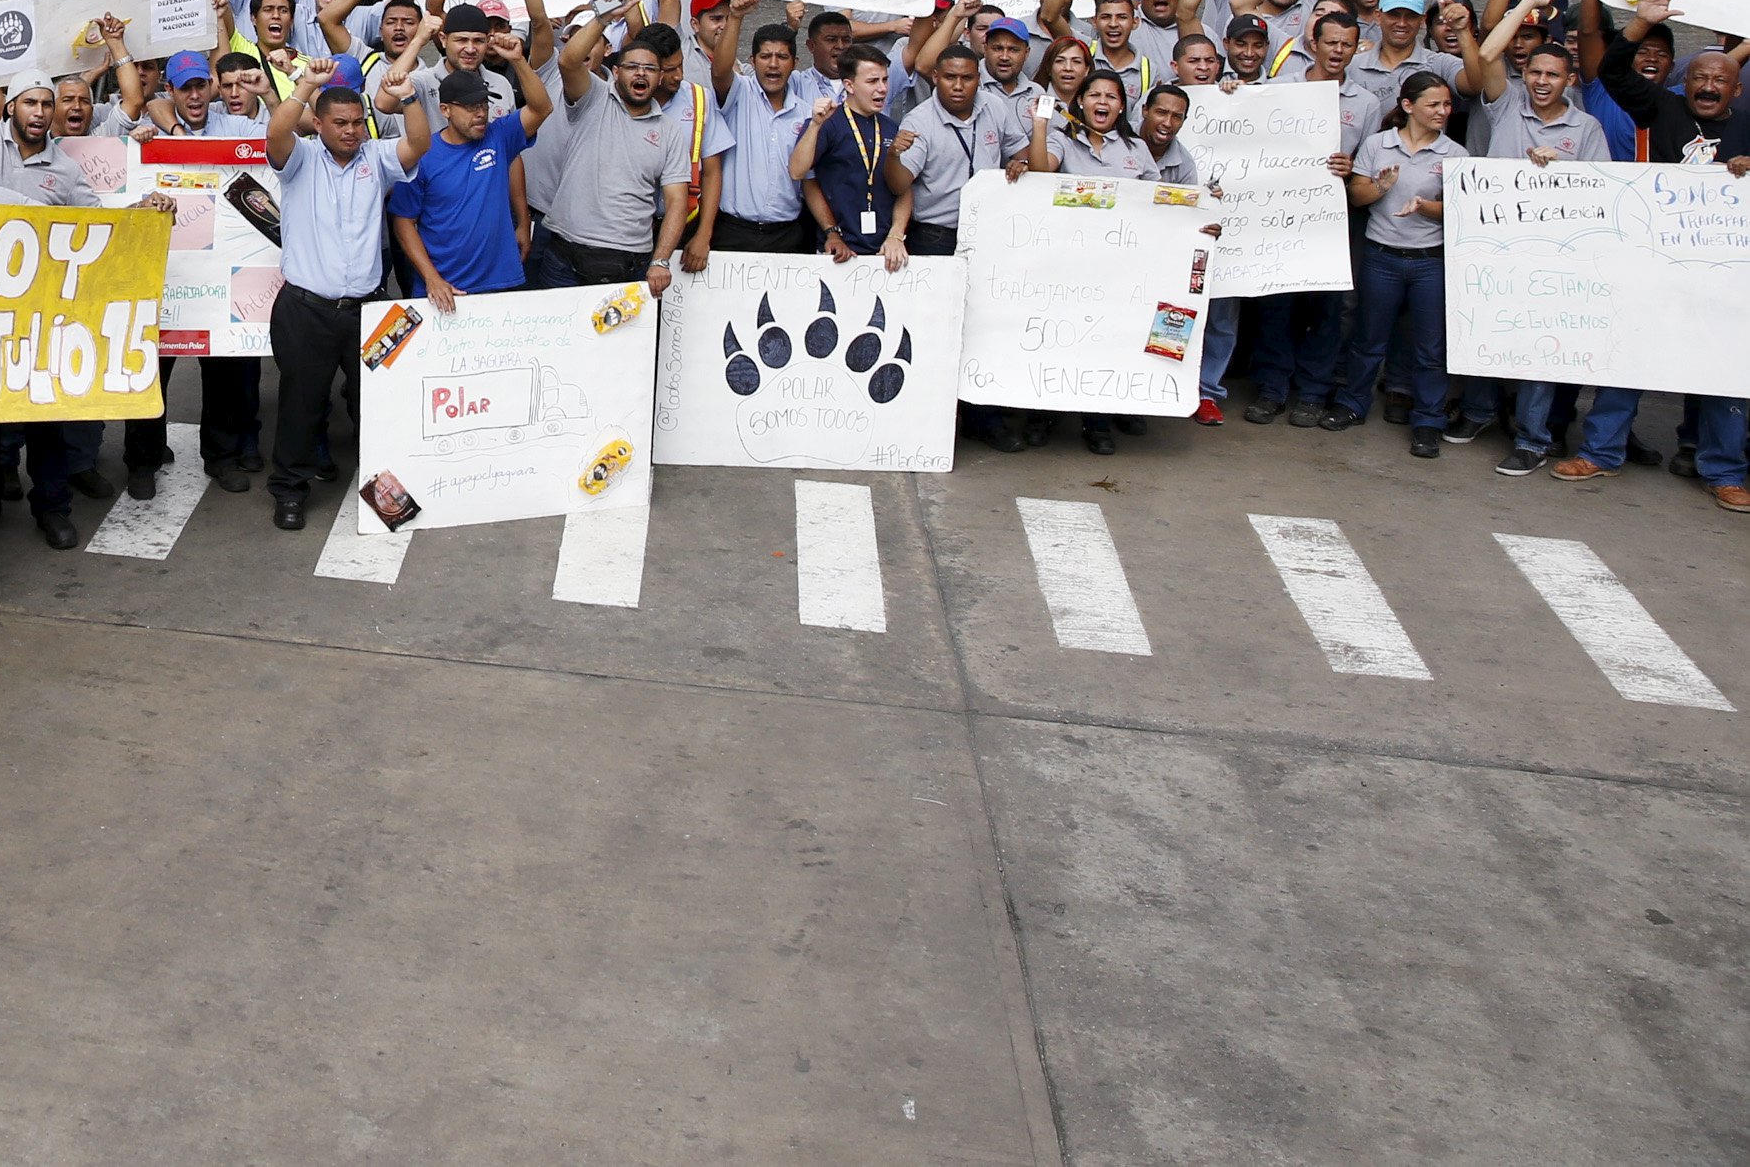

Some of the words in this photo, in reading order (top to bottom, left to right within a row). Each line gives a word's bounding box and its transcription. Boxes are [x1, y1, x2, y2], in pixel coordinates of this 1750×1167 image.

[157, 11, 200, 24] PRODUCCIÓN
[174, 5, 183, 13] LA
[162, 20, 196, 32] NACIONAL
[1192, 105, 1255, 136] Somos
[1266, 107, 1329, 136] Gente
[1239, 156, 1252, 182] y
[1257, 147, 1330, 170] hacemo
[1221, 190, 1257, 214] ayor
[1257, 191, 1273, 208] y
[1479, 204, 1507, 227] LA
[1217, 245, 1244, 256] nos
[1254, 237, 1307, 262] dejen
[1660, 231, 1682, 247] EN
[690, 262, 822, 291] ALIMENTOS
[1212, 262, 1285, 282] RABAJAR
[1527, 269, 1612, 304] ESTAMOS
[432, 312, 494, 334] Nosotros
[1019, 314, 1107, 352] 500%
[1458, 306, 1476, 337] Y
[101, 298, 160, 393] 15
[450, 356, 468, 374] LA
[778, 375, 838, 402] POLAR
[1027, 361, 1180, 404] VENEZUELA
[749, 407, 809, 436] SOMOS
[815, 407, 871, 434] TODOS
